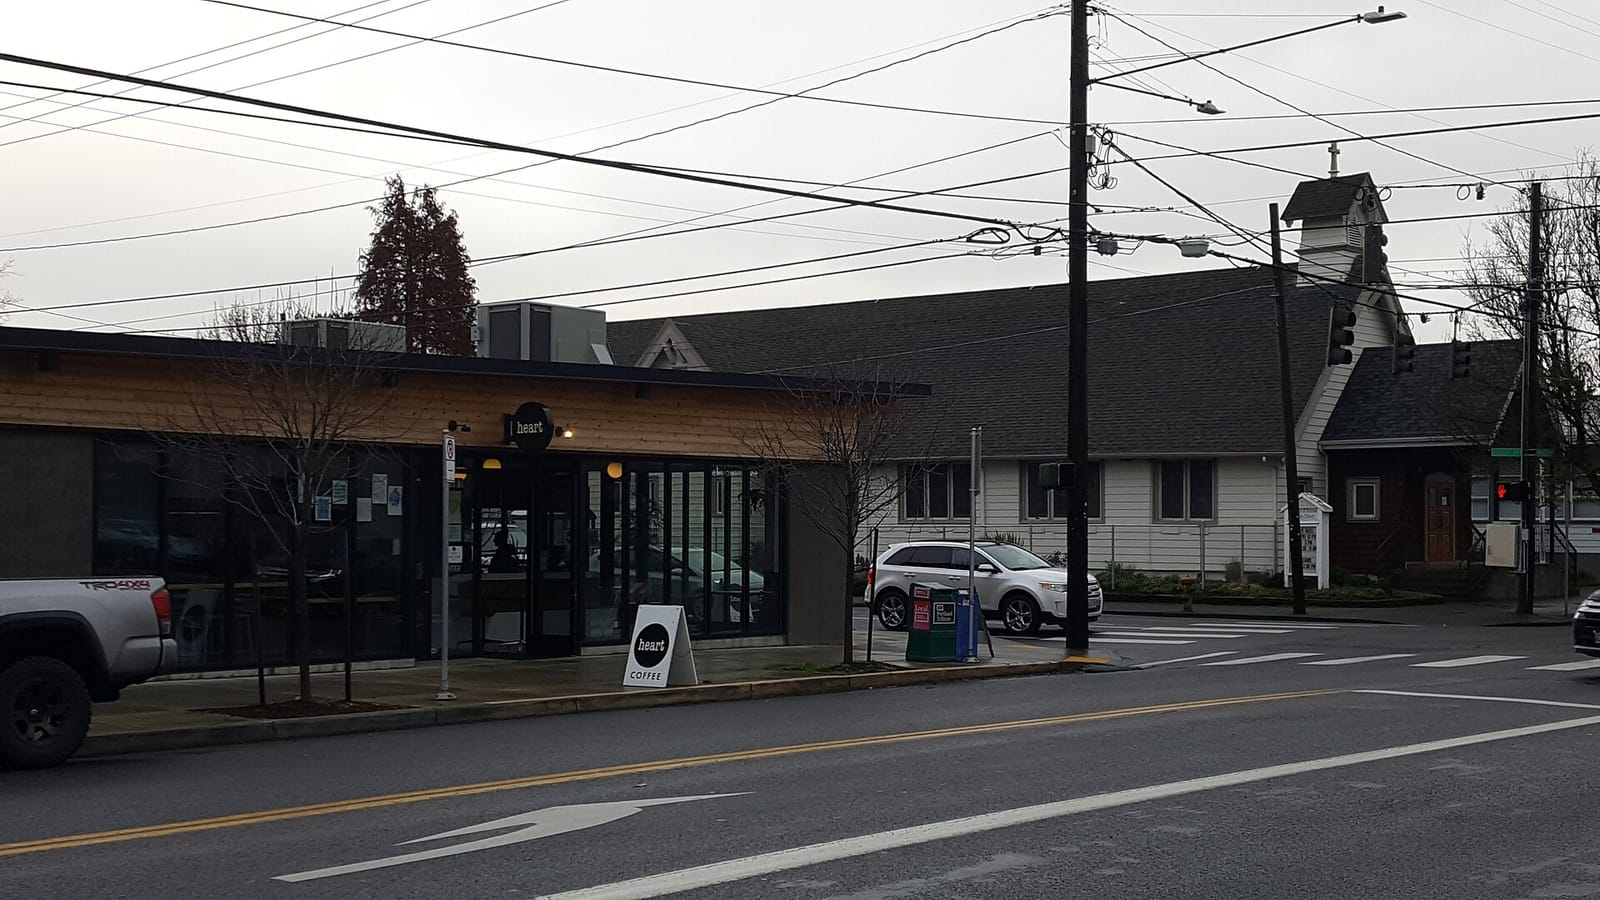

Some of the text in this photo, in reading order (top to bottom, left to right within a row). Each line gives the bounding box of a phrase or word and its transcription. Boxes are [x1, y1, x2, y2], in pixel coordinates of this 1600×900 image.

[516, 420, 544, 434] heart
[637, 638, 665, 651] heart
[630, 671, 662, 680] COFFEE
